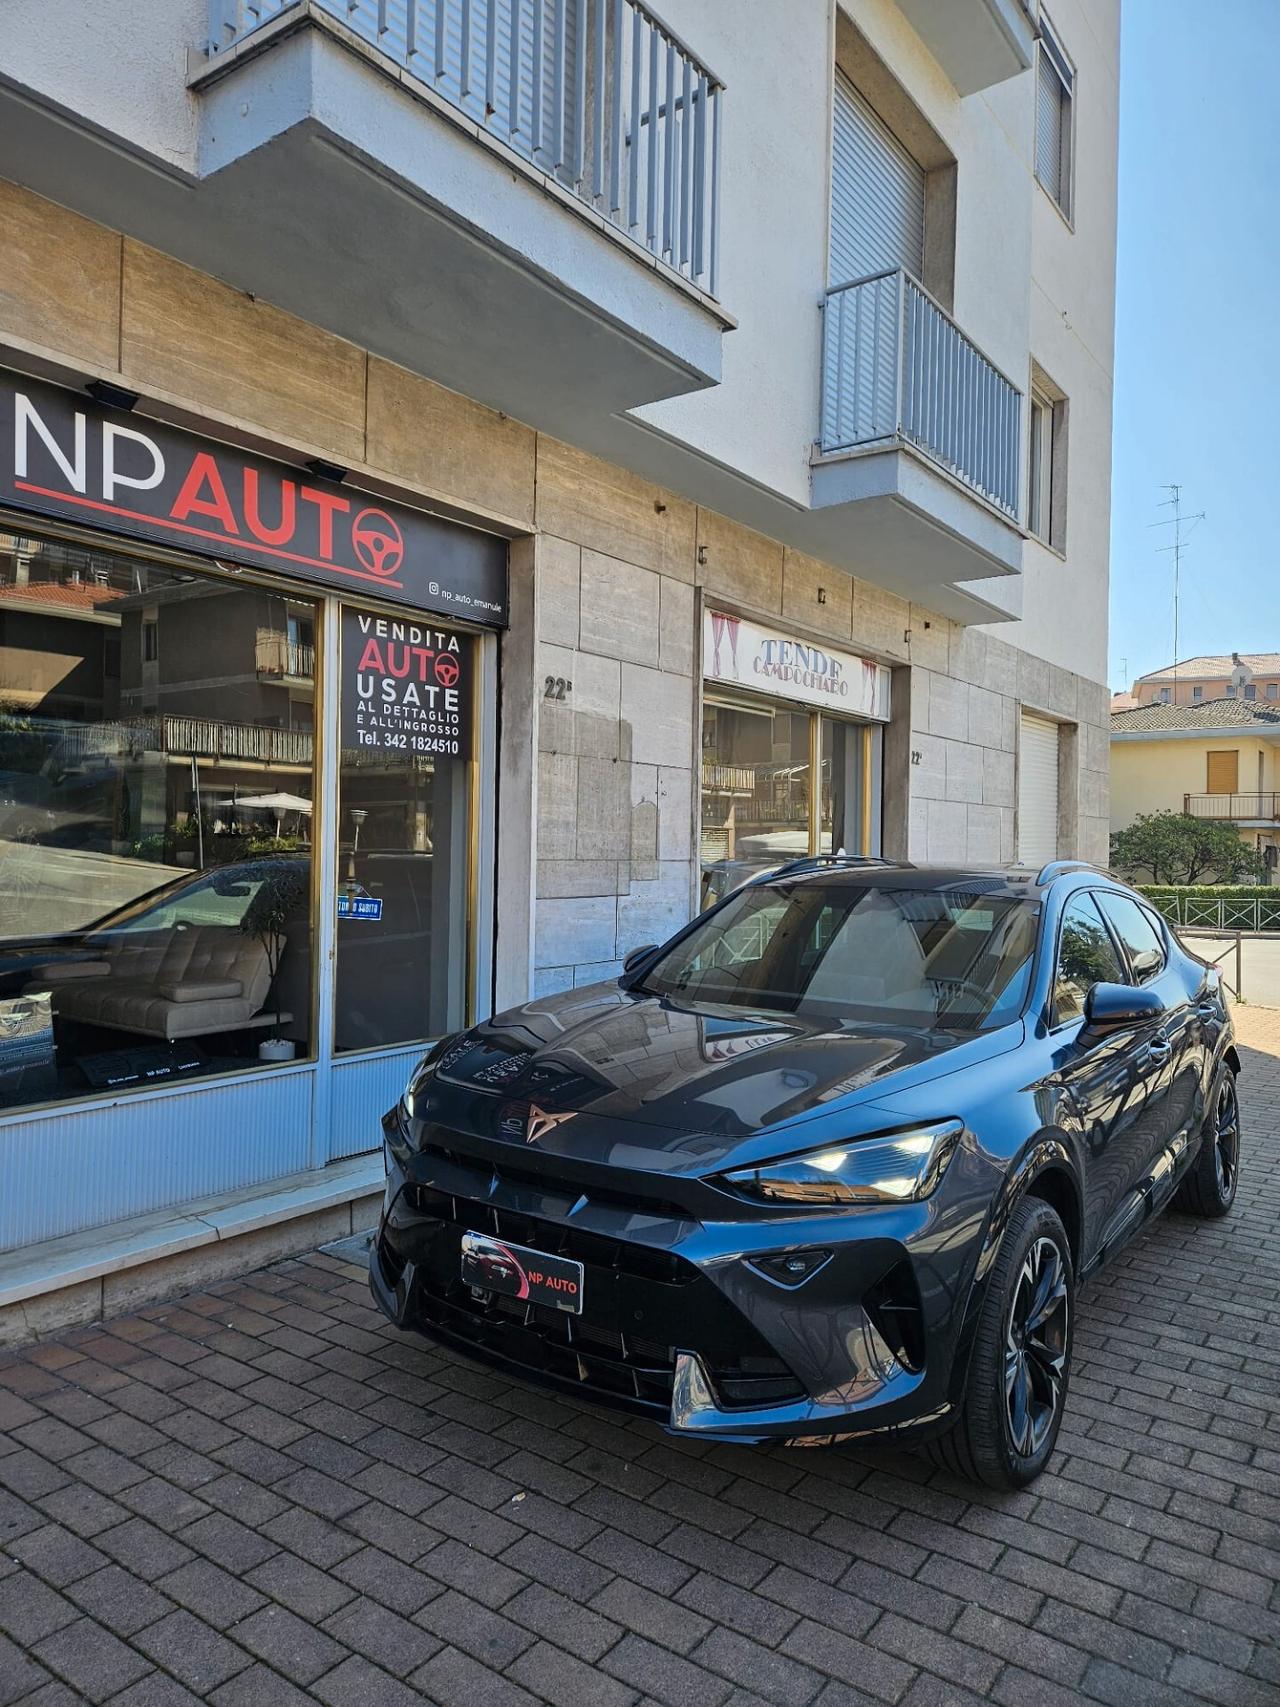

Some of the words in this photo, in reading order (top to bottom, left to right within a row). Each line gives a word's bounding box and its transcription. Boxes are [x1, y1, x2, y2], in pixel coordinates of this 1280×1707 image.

[358, 615, 460, 652] VENDITA
[358, 638, 460, 688] AUTO
[761, 639, 842, 679] TENDE
[356, 673, 459, 712] USATE
[357, 700, 376, 713] AL
[383, 703, 459, 724] DETTAGLIO
[357, 714, 364, 724] E
[370, 716, 459, 736] ALL'INGROSSO
[357, 729, 381, 746] Tel.
[384, 732, 407, 748] 342
[411, 736, 459, 754] 1824510
[528, 1271, 544, 1284] NP
[545, 1276, 578, 1294] AUTO
